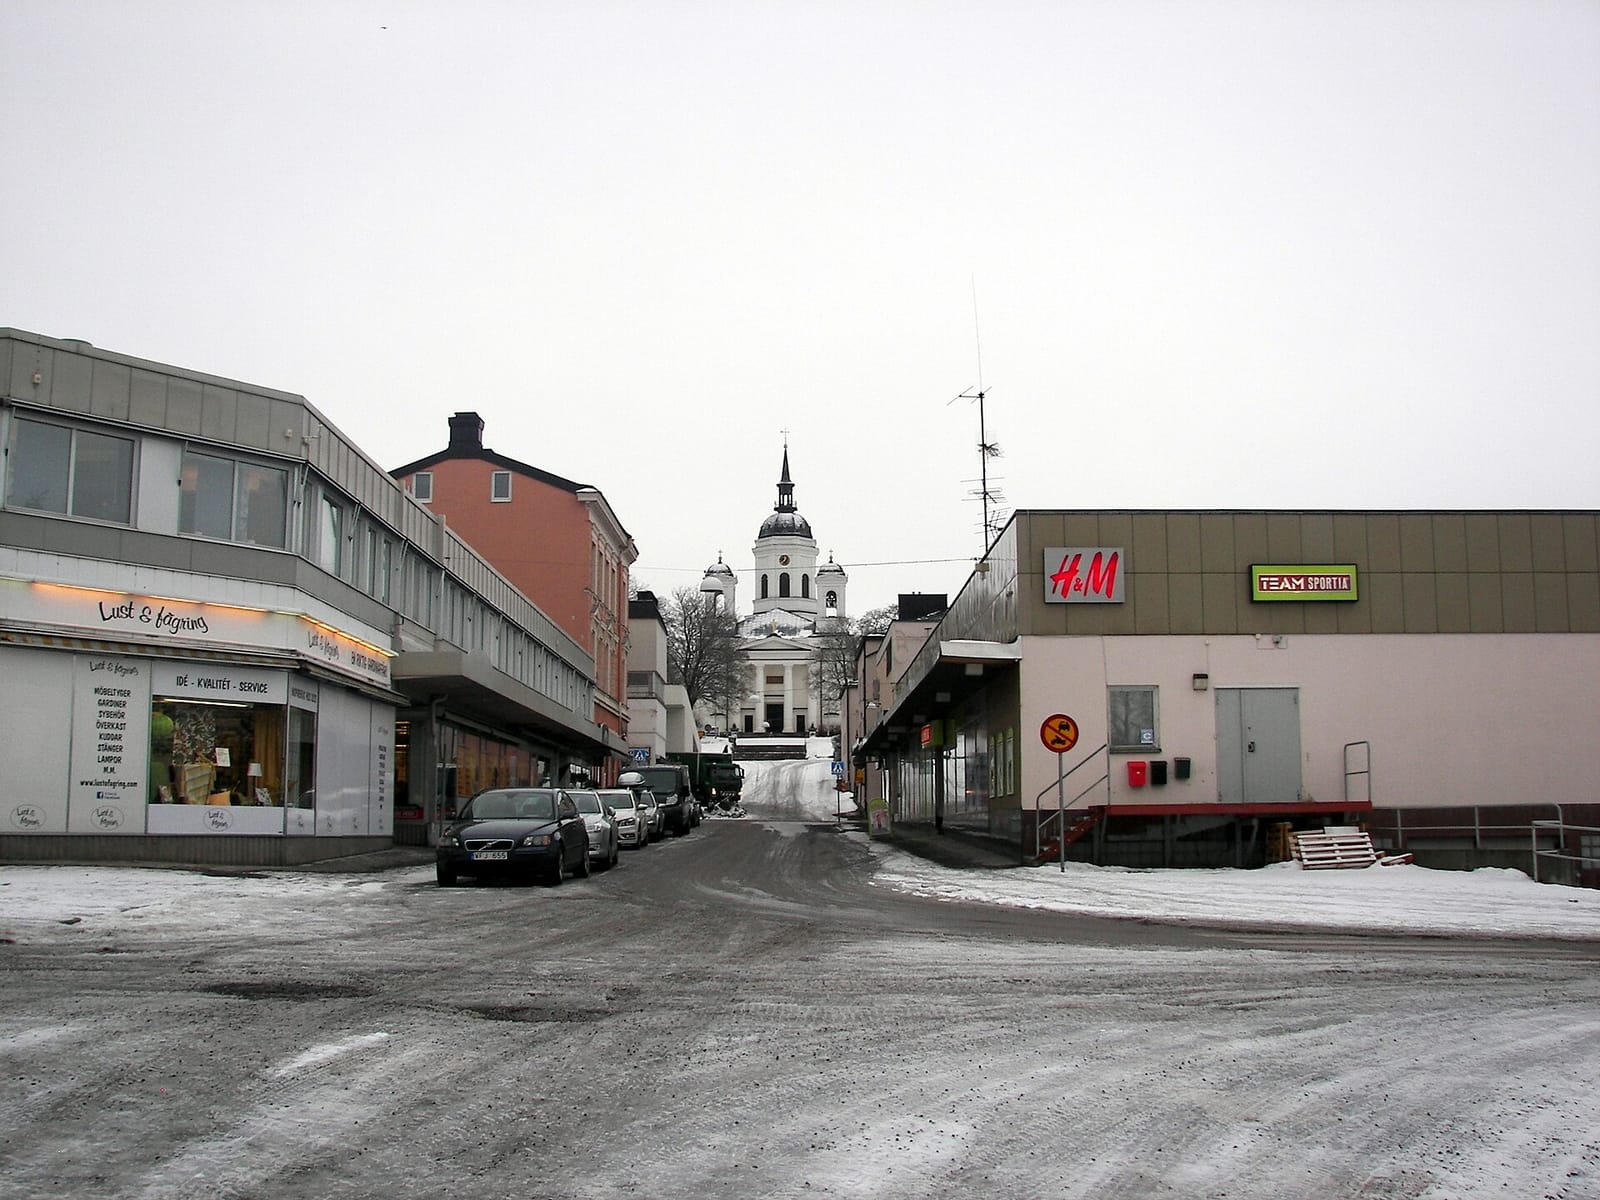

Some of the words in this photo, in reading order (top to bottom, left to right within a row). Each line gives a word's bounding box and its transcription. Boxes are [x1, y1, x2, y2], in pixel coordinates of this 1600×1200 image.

[1050, 551, 1119, 599] H&M
[1260, 577, 1305, 590] TEAM
[1307, 576, 1349, 590] SPORTIA
[99, 601, 135, 622] Lust
[139, 606, 152, 623] &
[176, 674, 188, 687] IDÉ
[238, 681, 268, 694] SERVICE
[97, 699, 127, 708] GARDINER
[99, 733, 123, 741] KUDDAR
[97, 755, 122, 764] LAMPOR
